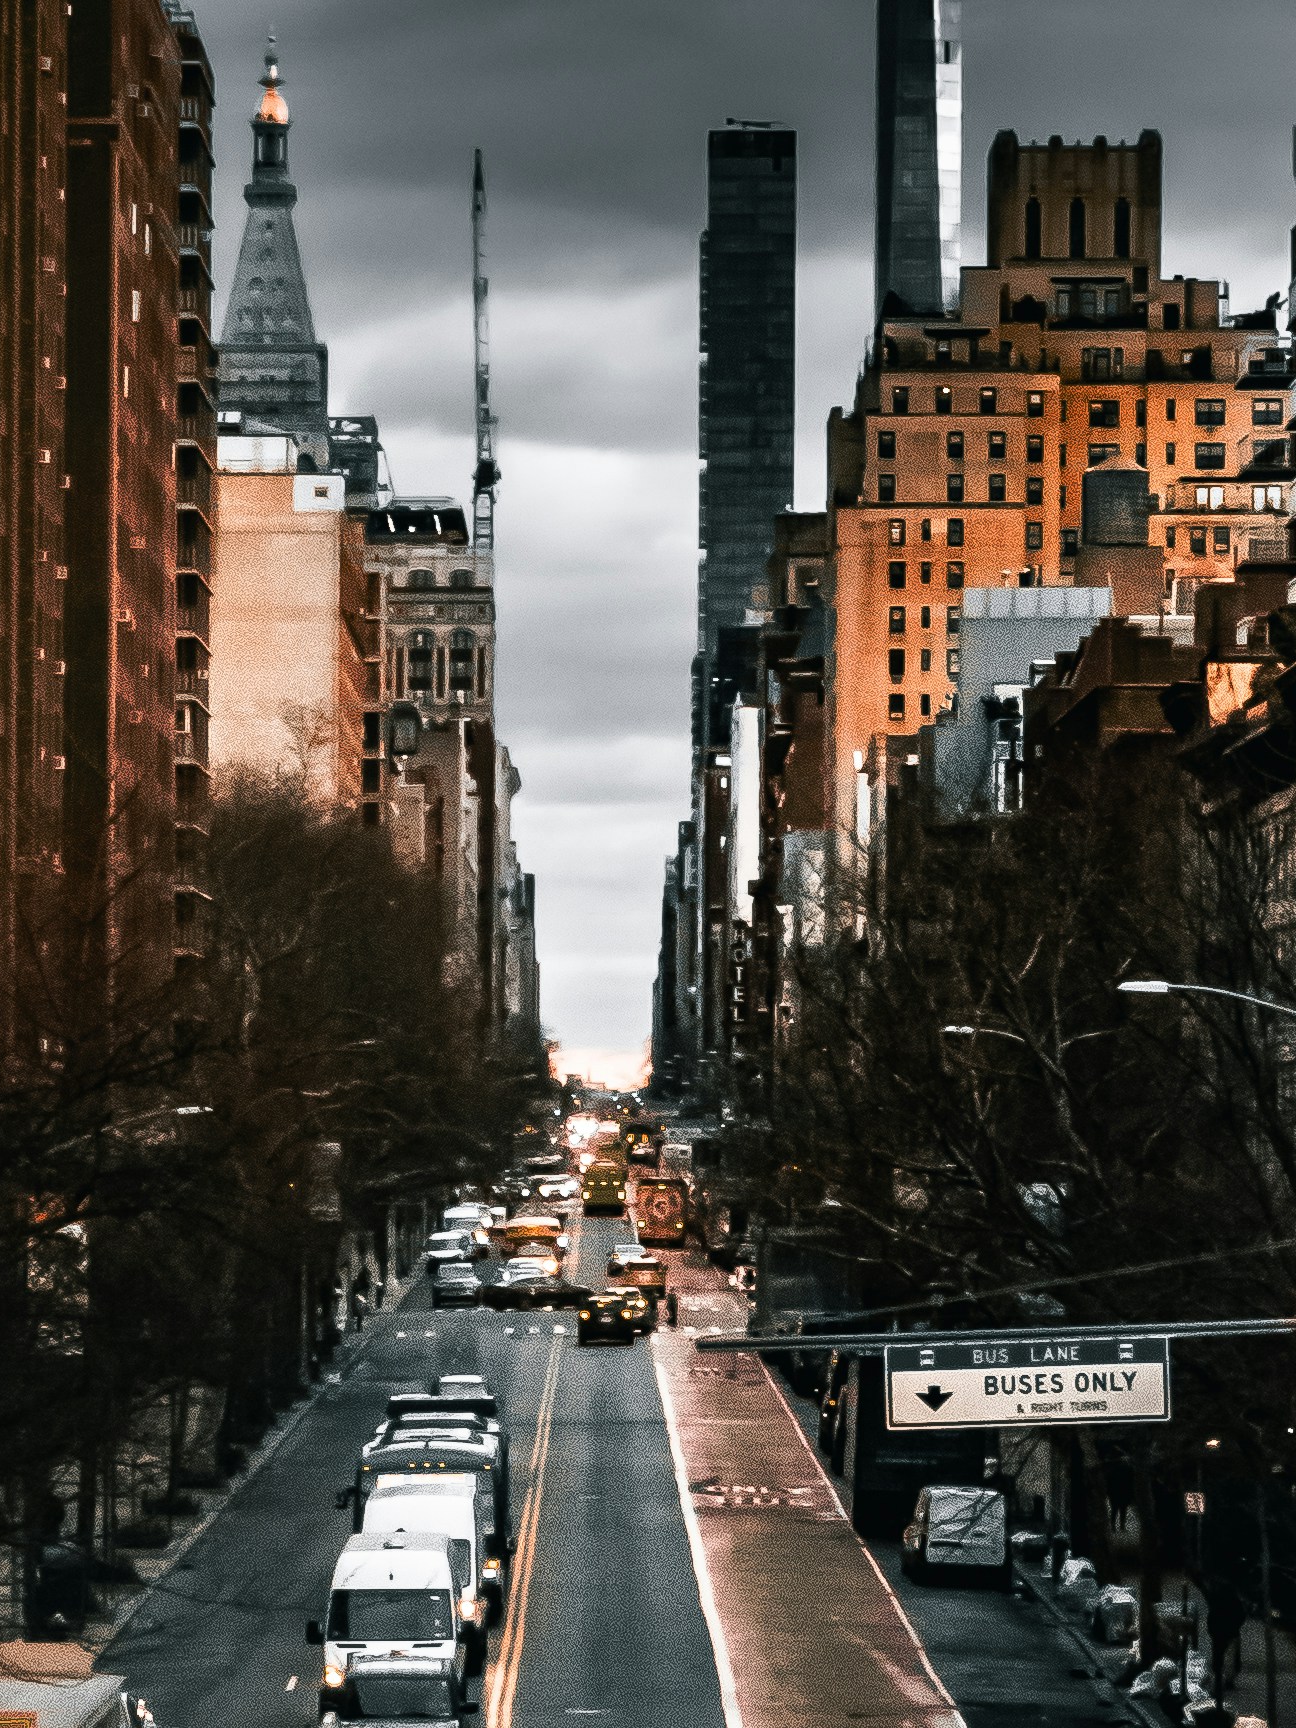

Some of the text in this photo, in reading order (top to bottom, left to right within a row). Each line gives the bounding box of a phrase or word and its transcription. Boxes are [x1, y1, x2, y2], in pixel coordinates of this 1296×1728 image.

[733, 928, 745, 1022] HOTEL
[972, 1346, 1080, 1364] BUS LANE
[984, 1371, 1137, 1396] BUSES ONLY
[1030, 1401, 1063, 1414] RIGHT
[1070, 1400, 1107, 1413] TURNS
